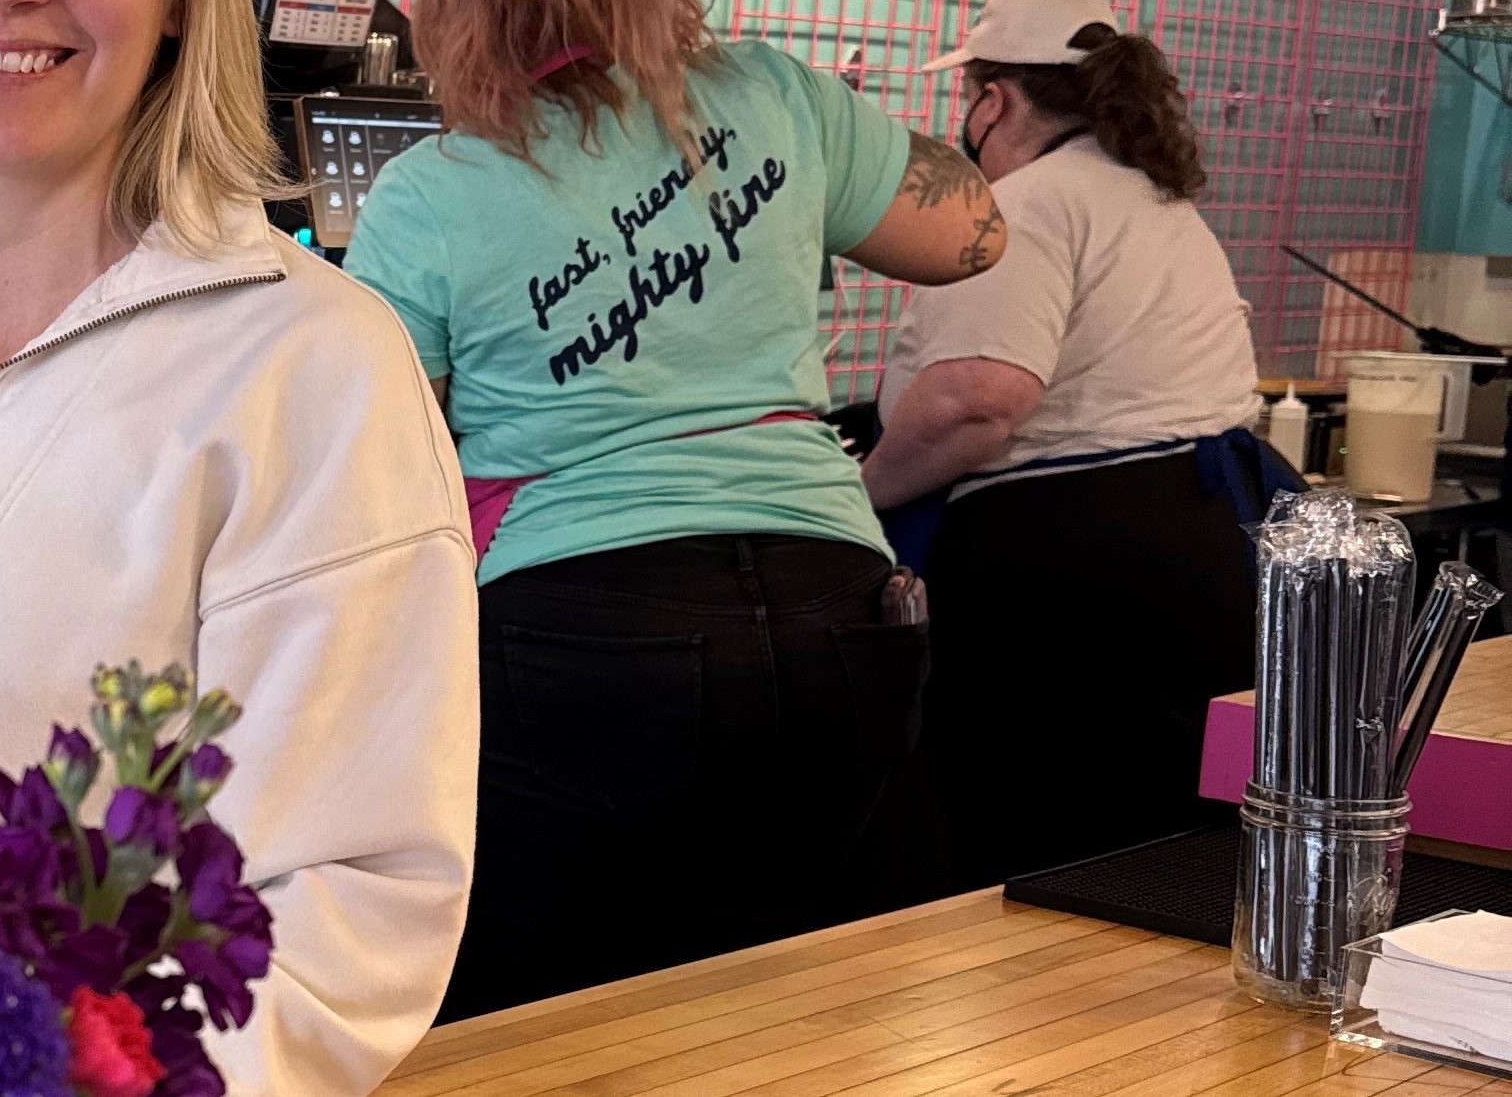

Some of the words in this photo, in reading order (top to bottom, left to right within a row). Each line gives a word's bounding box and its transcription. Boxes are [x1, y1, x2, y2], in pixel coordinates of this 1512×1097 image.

[528, 237, 611, 331] fast,
[549, 243, 710, 386] mighty
[708, 157, 786, 263] fine
